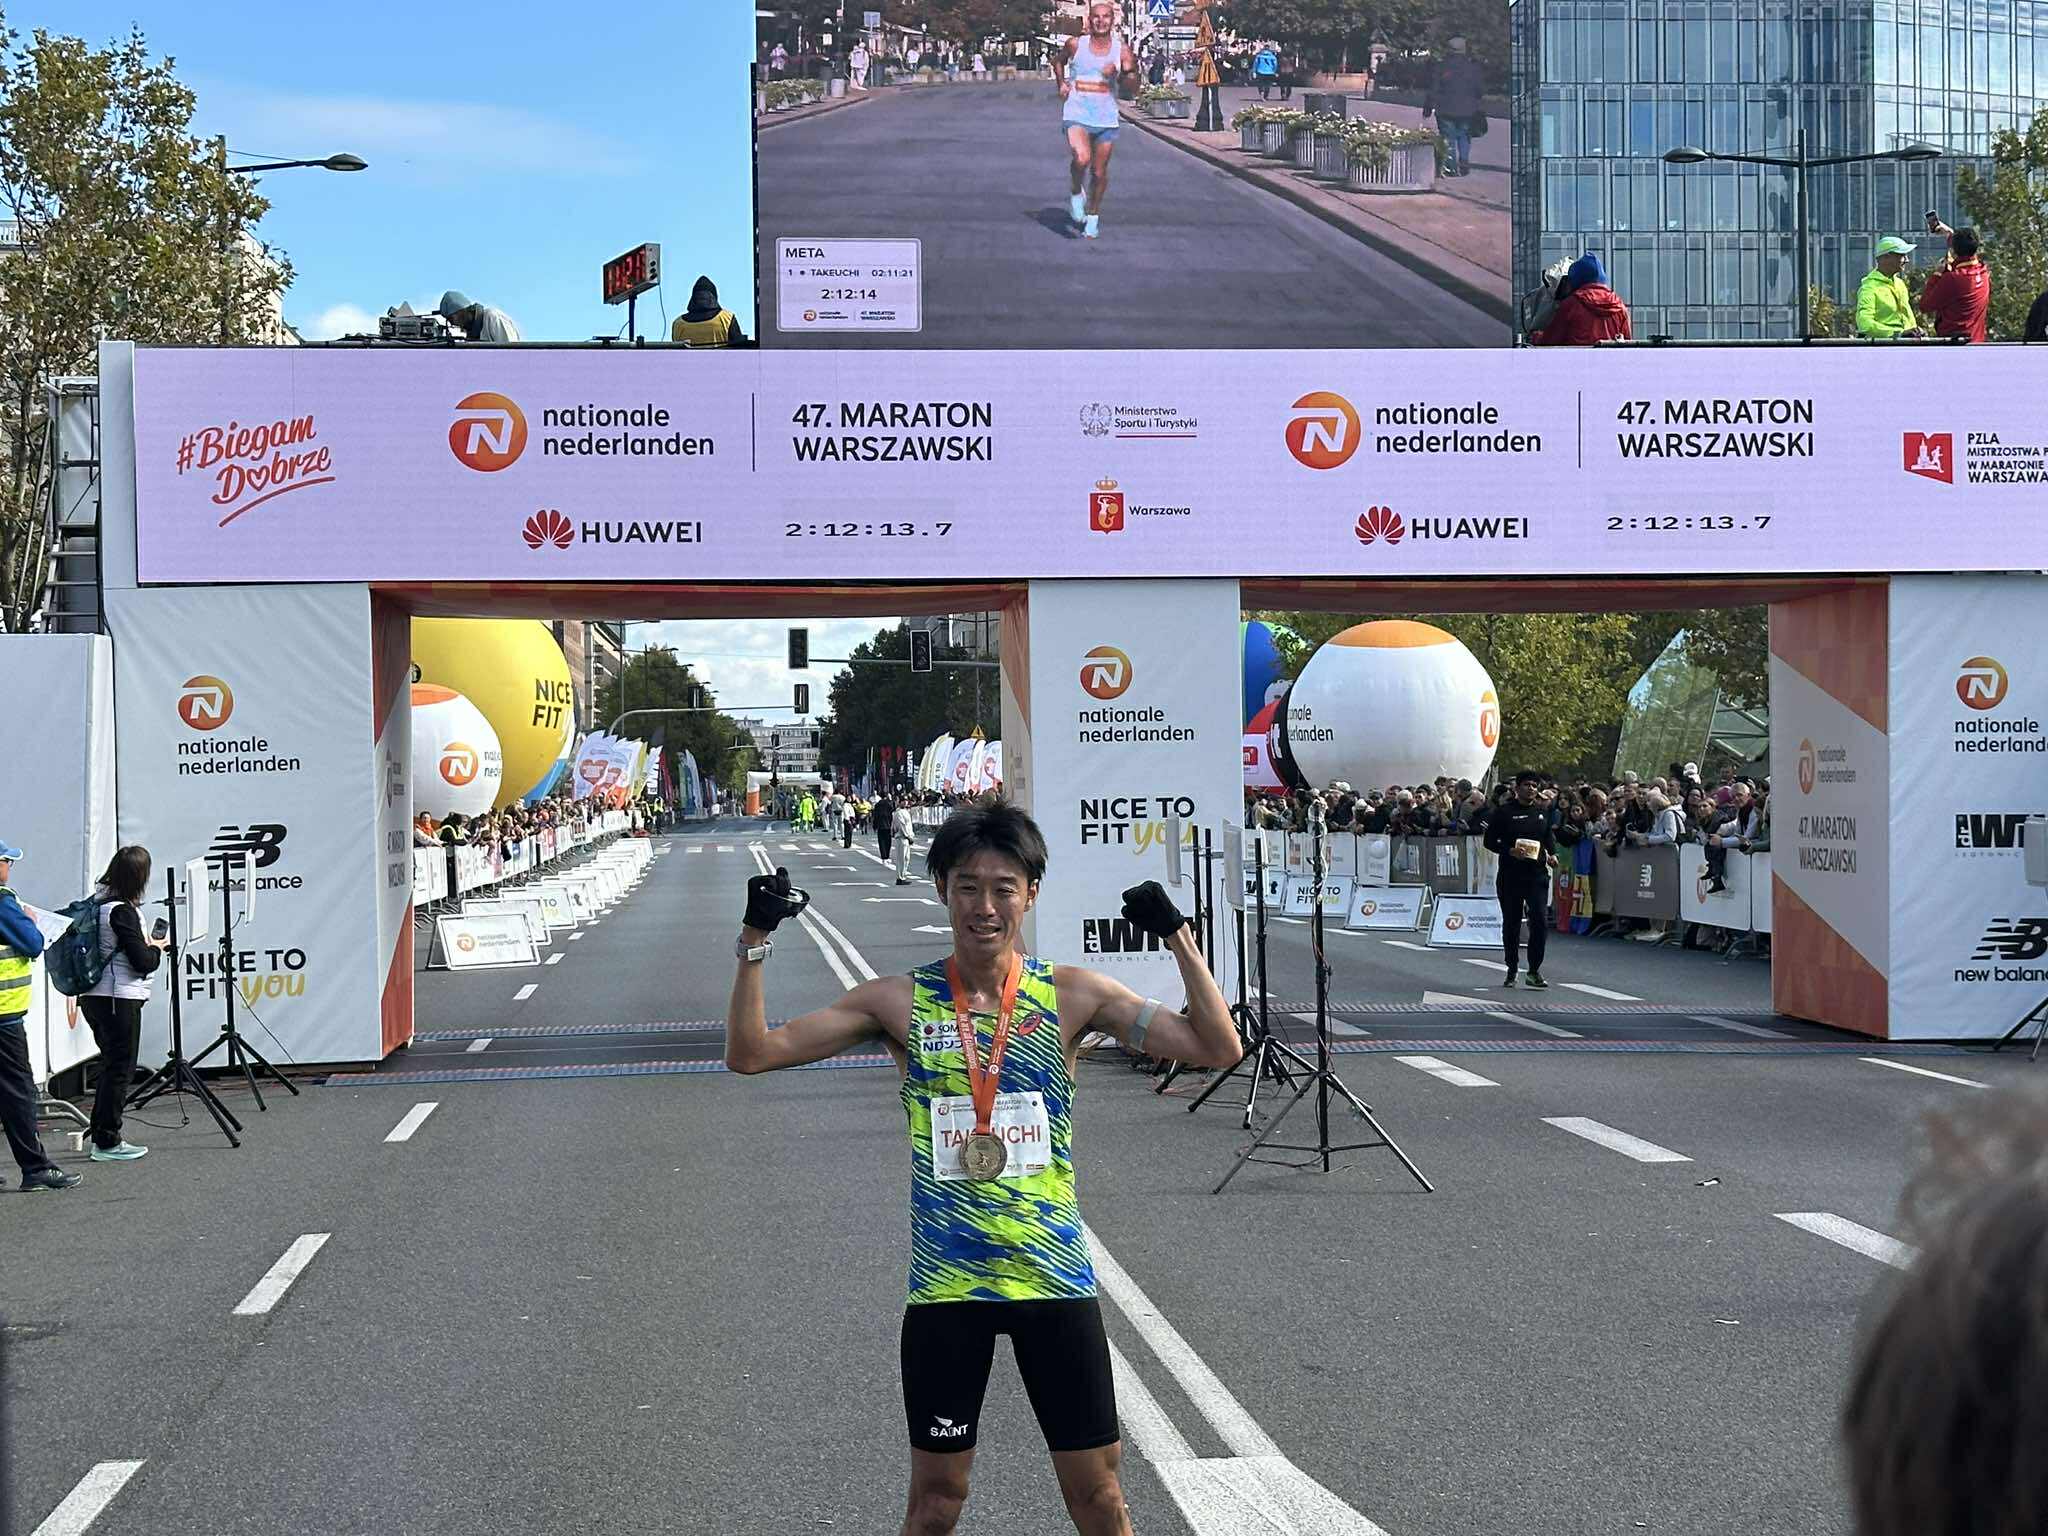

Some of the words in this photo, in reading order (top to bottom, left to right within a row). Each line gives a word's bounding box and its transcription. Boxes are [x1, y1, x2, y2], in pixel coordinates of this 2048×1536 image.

[785, 248, 825, 258] META
[811, 269, 860, 277] TAKEUCHI
[871, 269, 913, 277] 02:11:21
[821, 289, 877, 299] 2:12:14
[543, 404, 670, 427] nationale
[792, 404, 831, 428] 47.
[841, 402, 992, 428] MARATON
[1115, 406, 1177, 416] Ministerstwo
[1376, 402, 1498, 426] nationale
[1617, 402, 1656, 425] 47.
[1665, 400, 1814, 425] MARATON
[1115, 418, 1147, 430] Sportu
[1154, 418, 1198, 430] Turystyki
[177, 415, 316, 475] #Biegam
[543, 431, 714, 455] nederlanden
[1376, 430, 1541, 453] nederlanden
[1618, 433, 1814, 457] WARSZAWSKI
[1968, 433, 2000, 444] PZLA
[793, 437, 992, 462] WARSZAWSKI
[1967, 447, 2040, 457] MISTRZOSTWA
[1968, 461, 1978, 470] W
[1980, 460, 2044, 470] MARATONIE
[1129, 506, 1191, 515] Warszawa
[785, 522, 953, 537] 2:12:13.7
[1412, 517, 1528, 539] HUAWEI
[1608, 516, 1772, 530] 2:12:13.7
[581, 523, 703, 543] HUAWEI
[536, 678, 570, 704] NICE
[533, 704, 562, 728] FIT
[1079, 706, 1164, 723] nationale
[1079, 725, 1194, 742] nederlanden
[1955, 717, 2039, 733] nationale
[178, 736, 269, 754] nationale
[1955, 736, 2048, 752] nederland
[178, 756, 301, 775] nederlanden
[1081, 798, 1147, 819] NICE
[1156, 797, 1195, 818] TO
[1081, 823, 1129, 844] FIT
[1799, 817, 1810, 837] 47.
[1811, 816, 1856, 840] MARATON
[1799, 847, 1856, 873] WARSZAWSKI
[1326, 887, 1341, 895] TO
[265, 948, 306, 970] TO
[1955, 969, 1990, 981] new
[1995, 966, 2048, 981] balan
[241, 974, 304, 1008] you
[930, 1424, 968, 1437] SAINT
